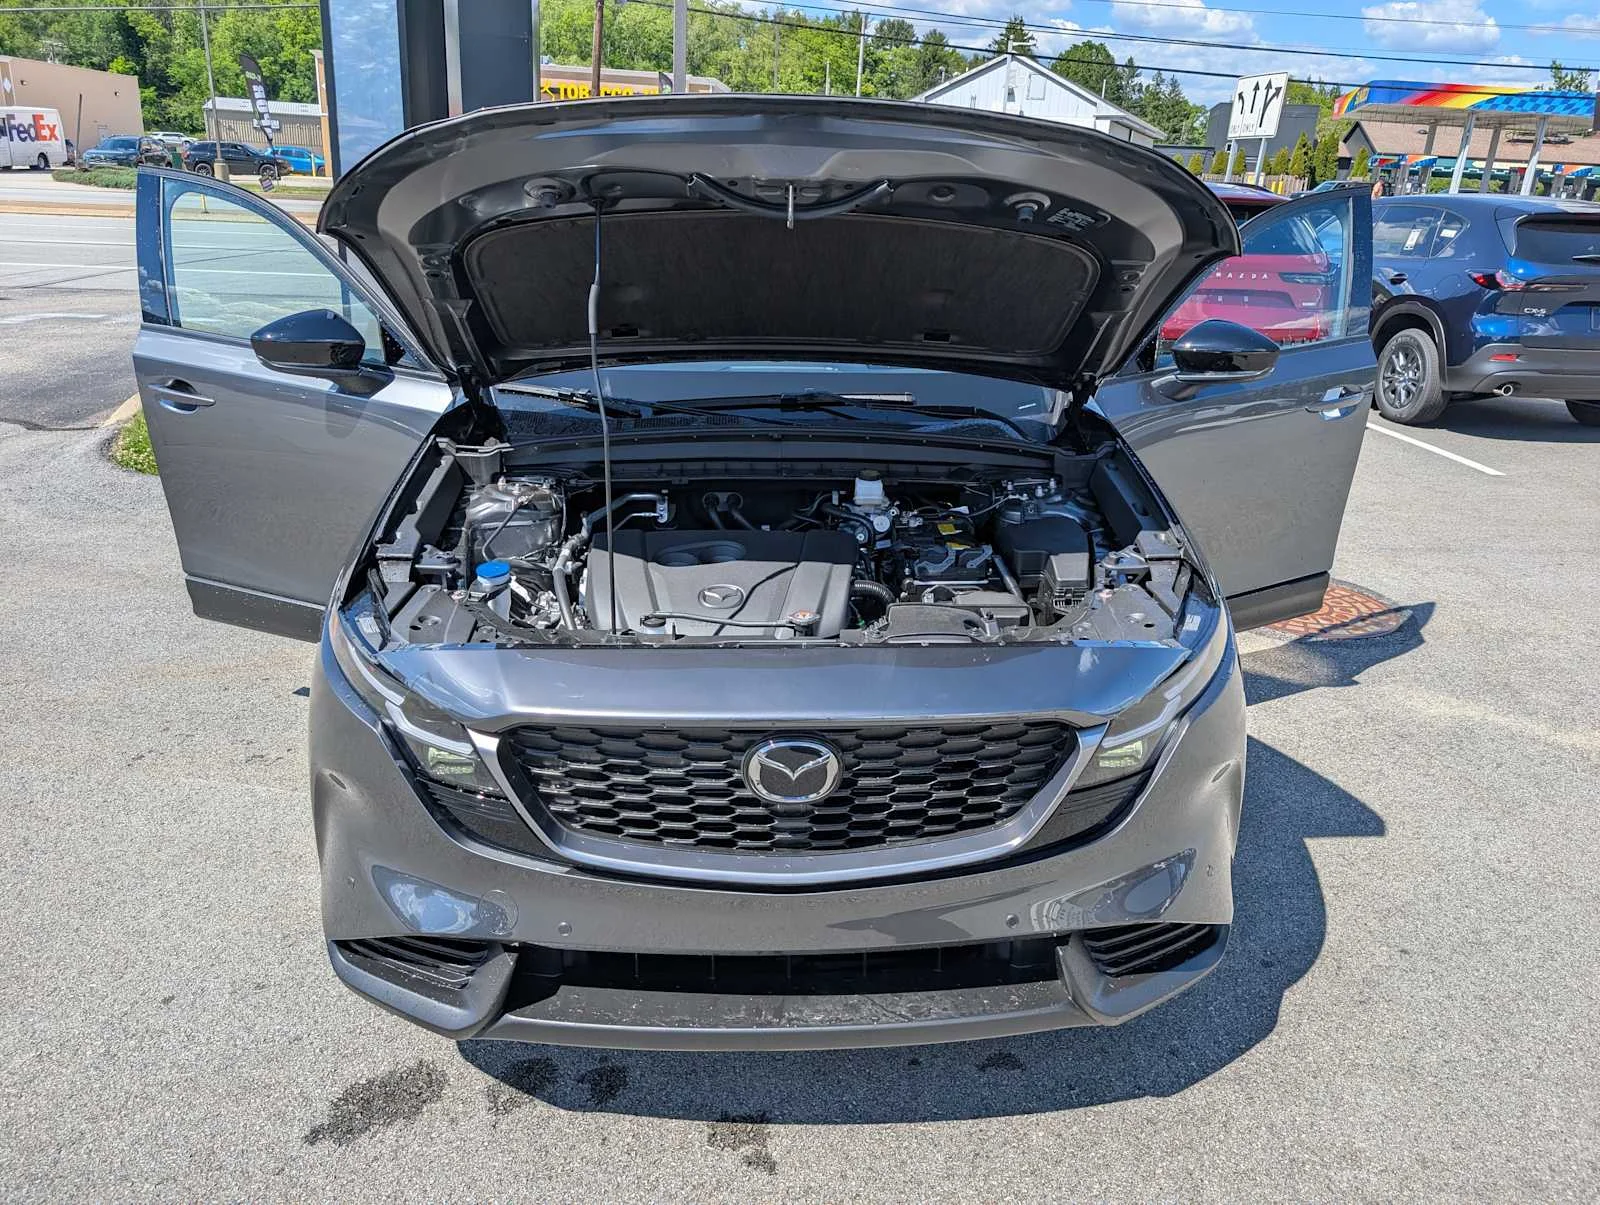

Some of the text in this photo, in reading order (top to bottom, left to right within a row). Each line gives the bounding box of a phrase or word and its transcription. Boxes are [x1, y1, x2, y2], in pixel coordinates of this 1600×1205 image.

[558, 83, 634, 100] TOBCCO
[6, 113, 59, 142] FedEx
[1215, 271, 1269, 280] MAZDA
